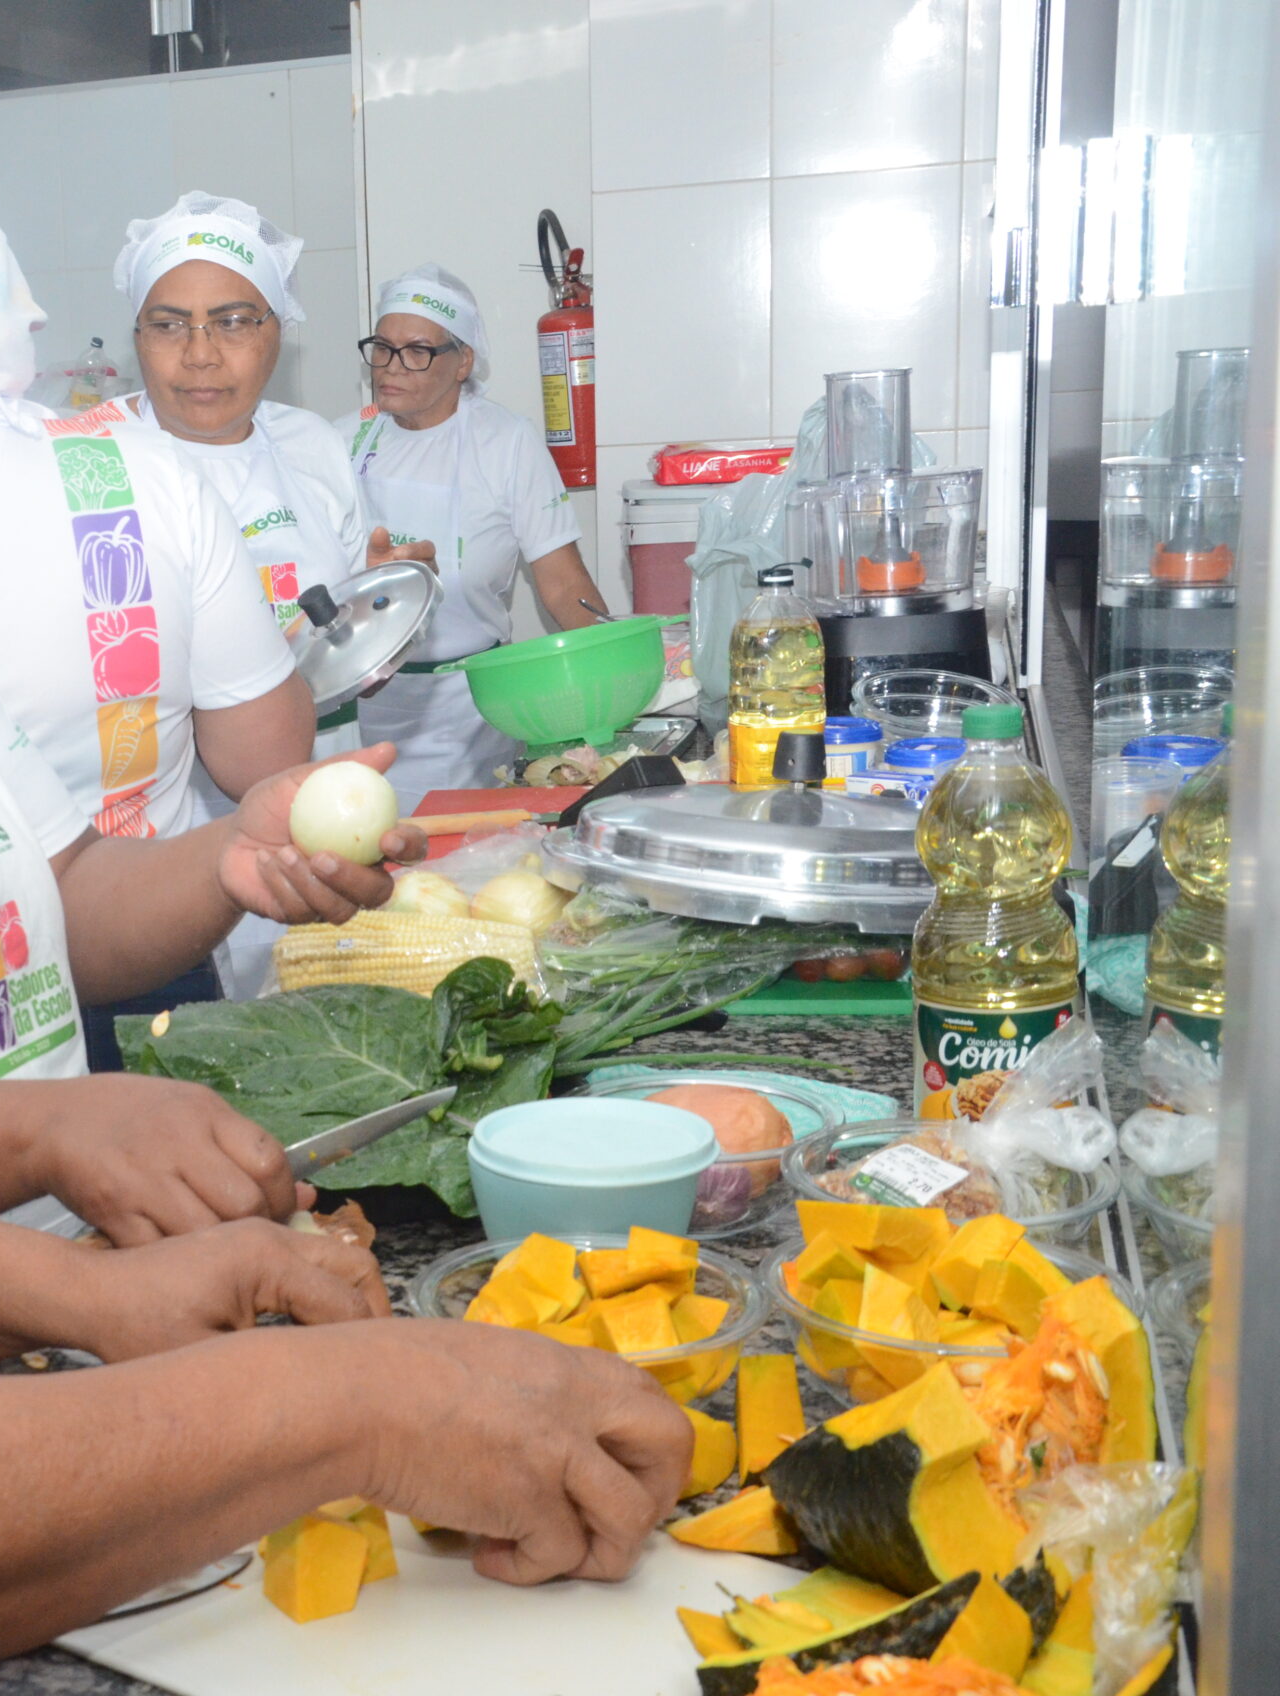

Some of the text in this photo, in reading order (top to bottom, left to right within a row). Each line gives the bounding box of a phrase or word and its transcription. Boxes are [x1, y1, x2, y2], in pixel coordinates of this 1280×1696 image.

[202, 232, 254, 265] GOIÁS
[421, 296, 457, 319] GOIÁS
[682, 461, 720, 474] LIANE
[9, 962, 61, 1007] Sabores
[32, 987, 72, 1027] Escola
[938, 1032, 1032, 1070] Comi
[967, 1037, 986, 1047] Óleo
[987, 1038, 998, 1047] de
